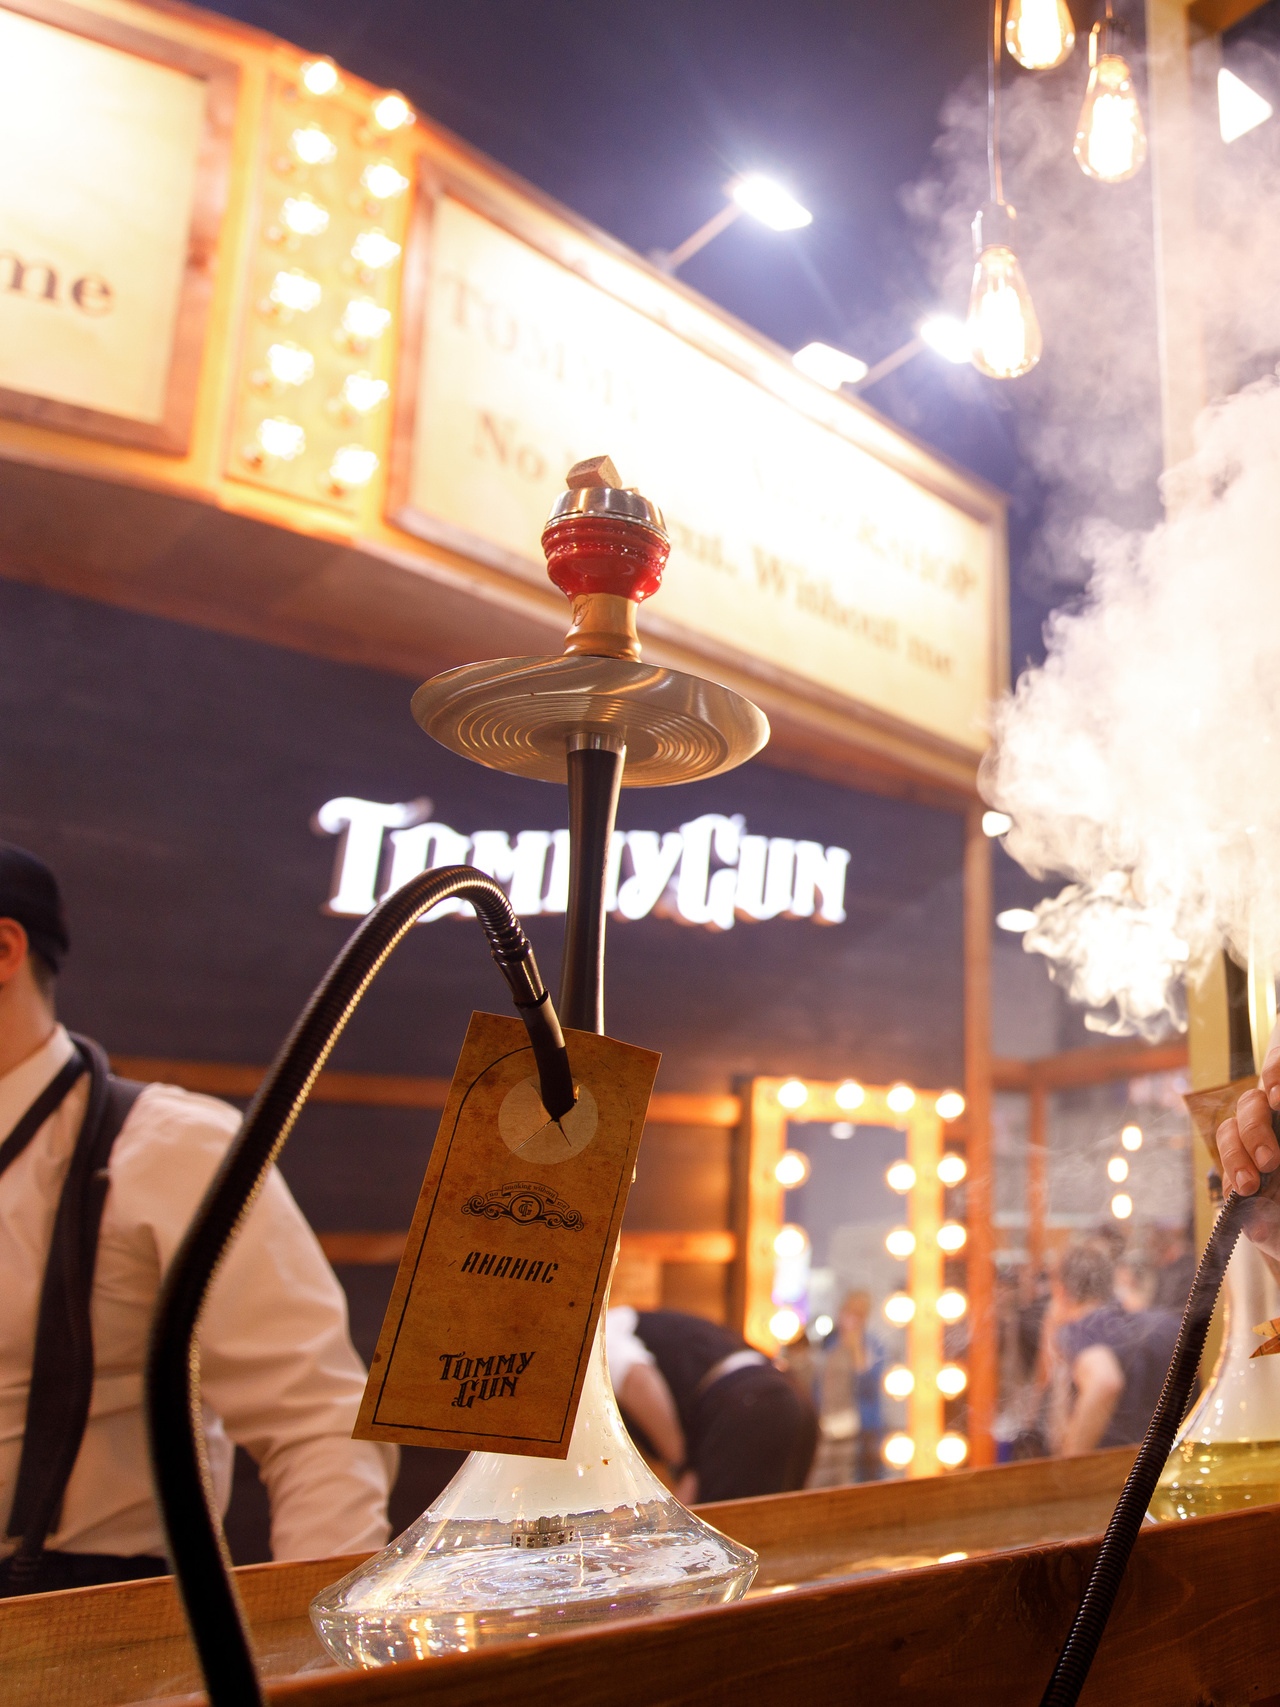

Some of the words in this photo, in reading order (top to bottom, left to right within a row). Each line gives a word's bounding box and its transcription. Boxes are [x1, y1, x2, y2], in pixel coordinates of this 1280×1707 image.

[472, 408, 547, 484] No
[504, 1183, 532, 1192] smoking
[532, 1185, 557, 1200] without
